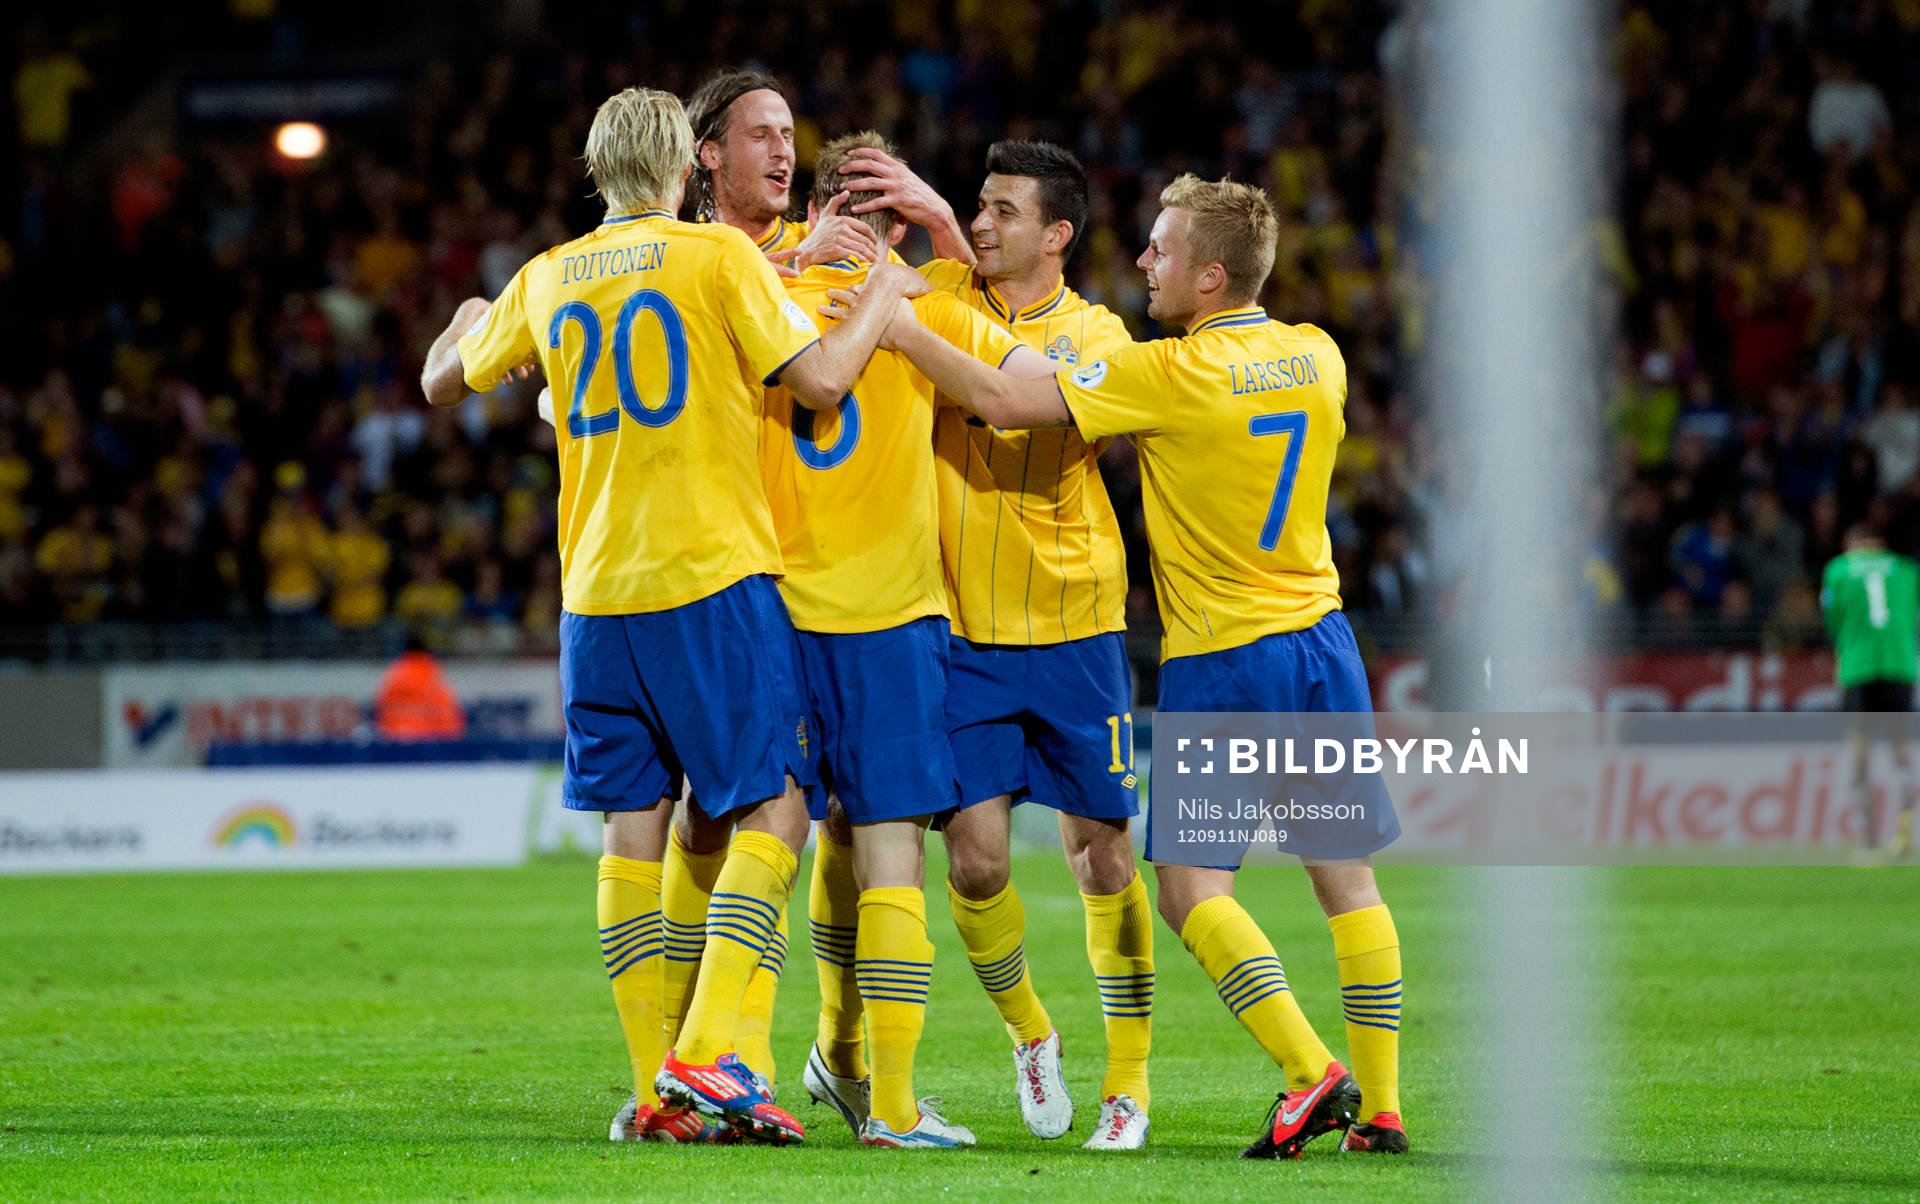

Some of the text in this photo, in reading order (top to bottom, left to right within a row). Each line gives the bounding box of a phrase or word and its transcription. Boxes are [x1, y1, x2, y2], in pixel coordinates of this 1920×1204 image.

[562, 242, 667, 284] TOIVONEN
[549, 288, 688, 439] 20
[1228, 354, 1320, 395] LARSSON
[1249, 410, 1309, 551] 7
